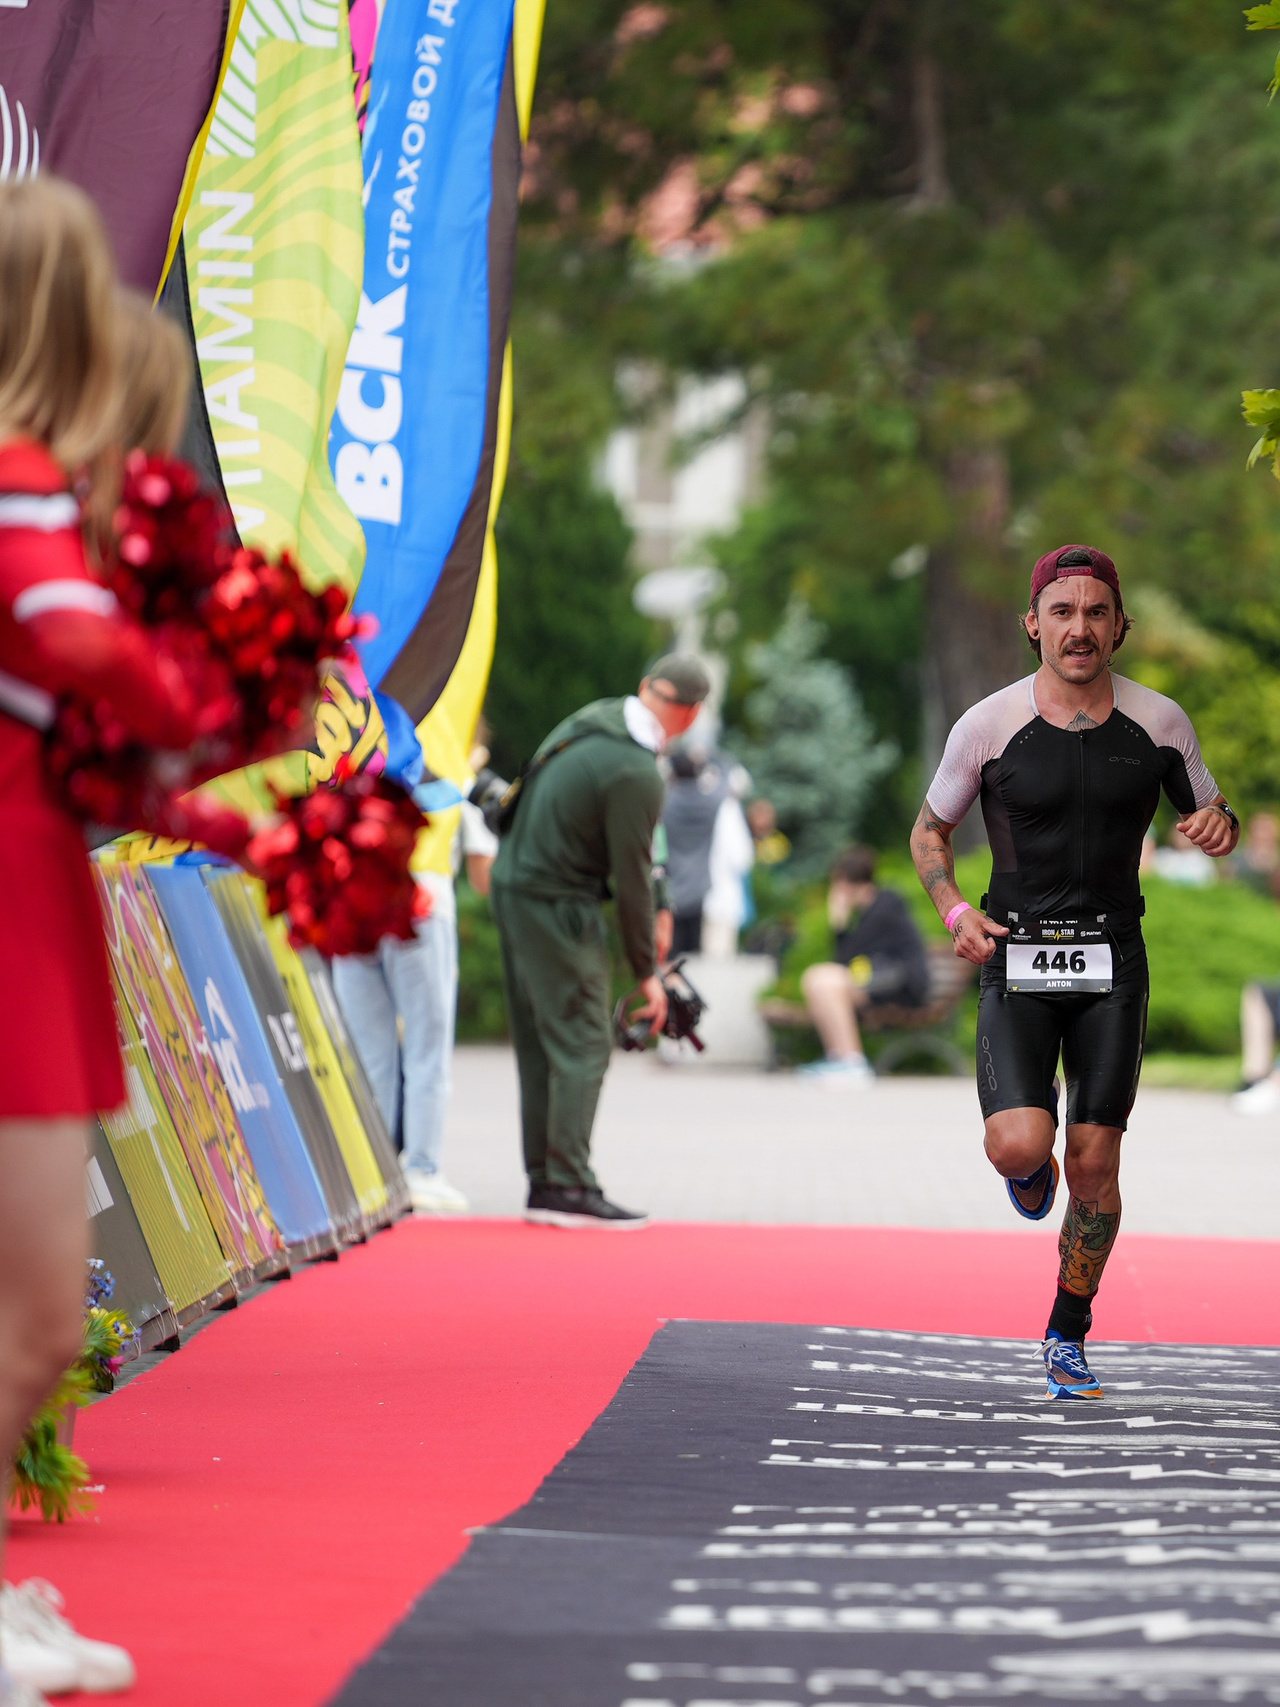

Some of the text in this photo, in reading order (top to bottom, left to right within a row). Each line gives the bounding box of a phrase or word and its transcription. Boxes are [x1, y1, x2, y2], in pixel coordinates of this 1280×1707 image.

[335, 282, 409, 526] ВСК
[386, 33, 446, 279] СТРАХОВОЙ
[1108, 756, 1141, 765] orca
[1060, 928, 1075, 936] STAR
[1032, 950, 1086, 974] 446
[1046, 980, 1072, 988] ANTON
[981, 1035, 998, 1091] orca
[793, 1402, 1065, 1422] IRON
